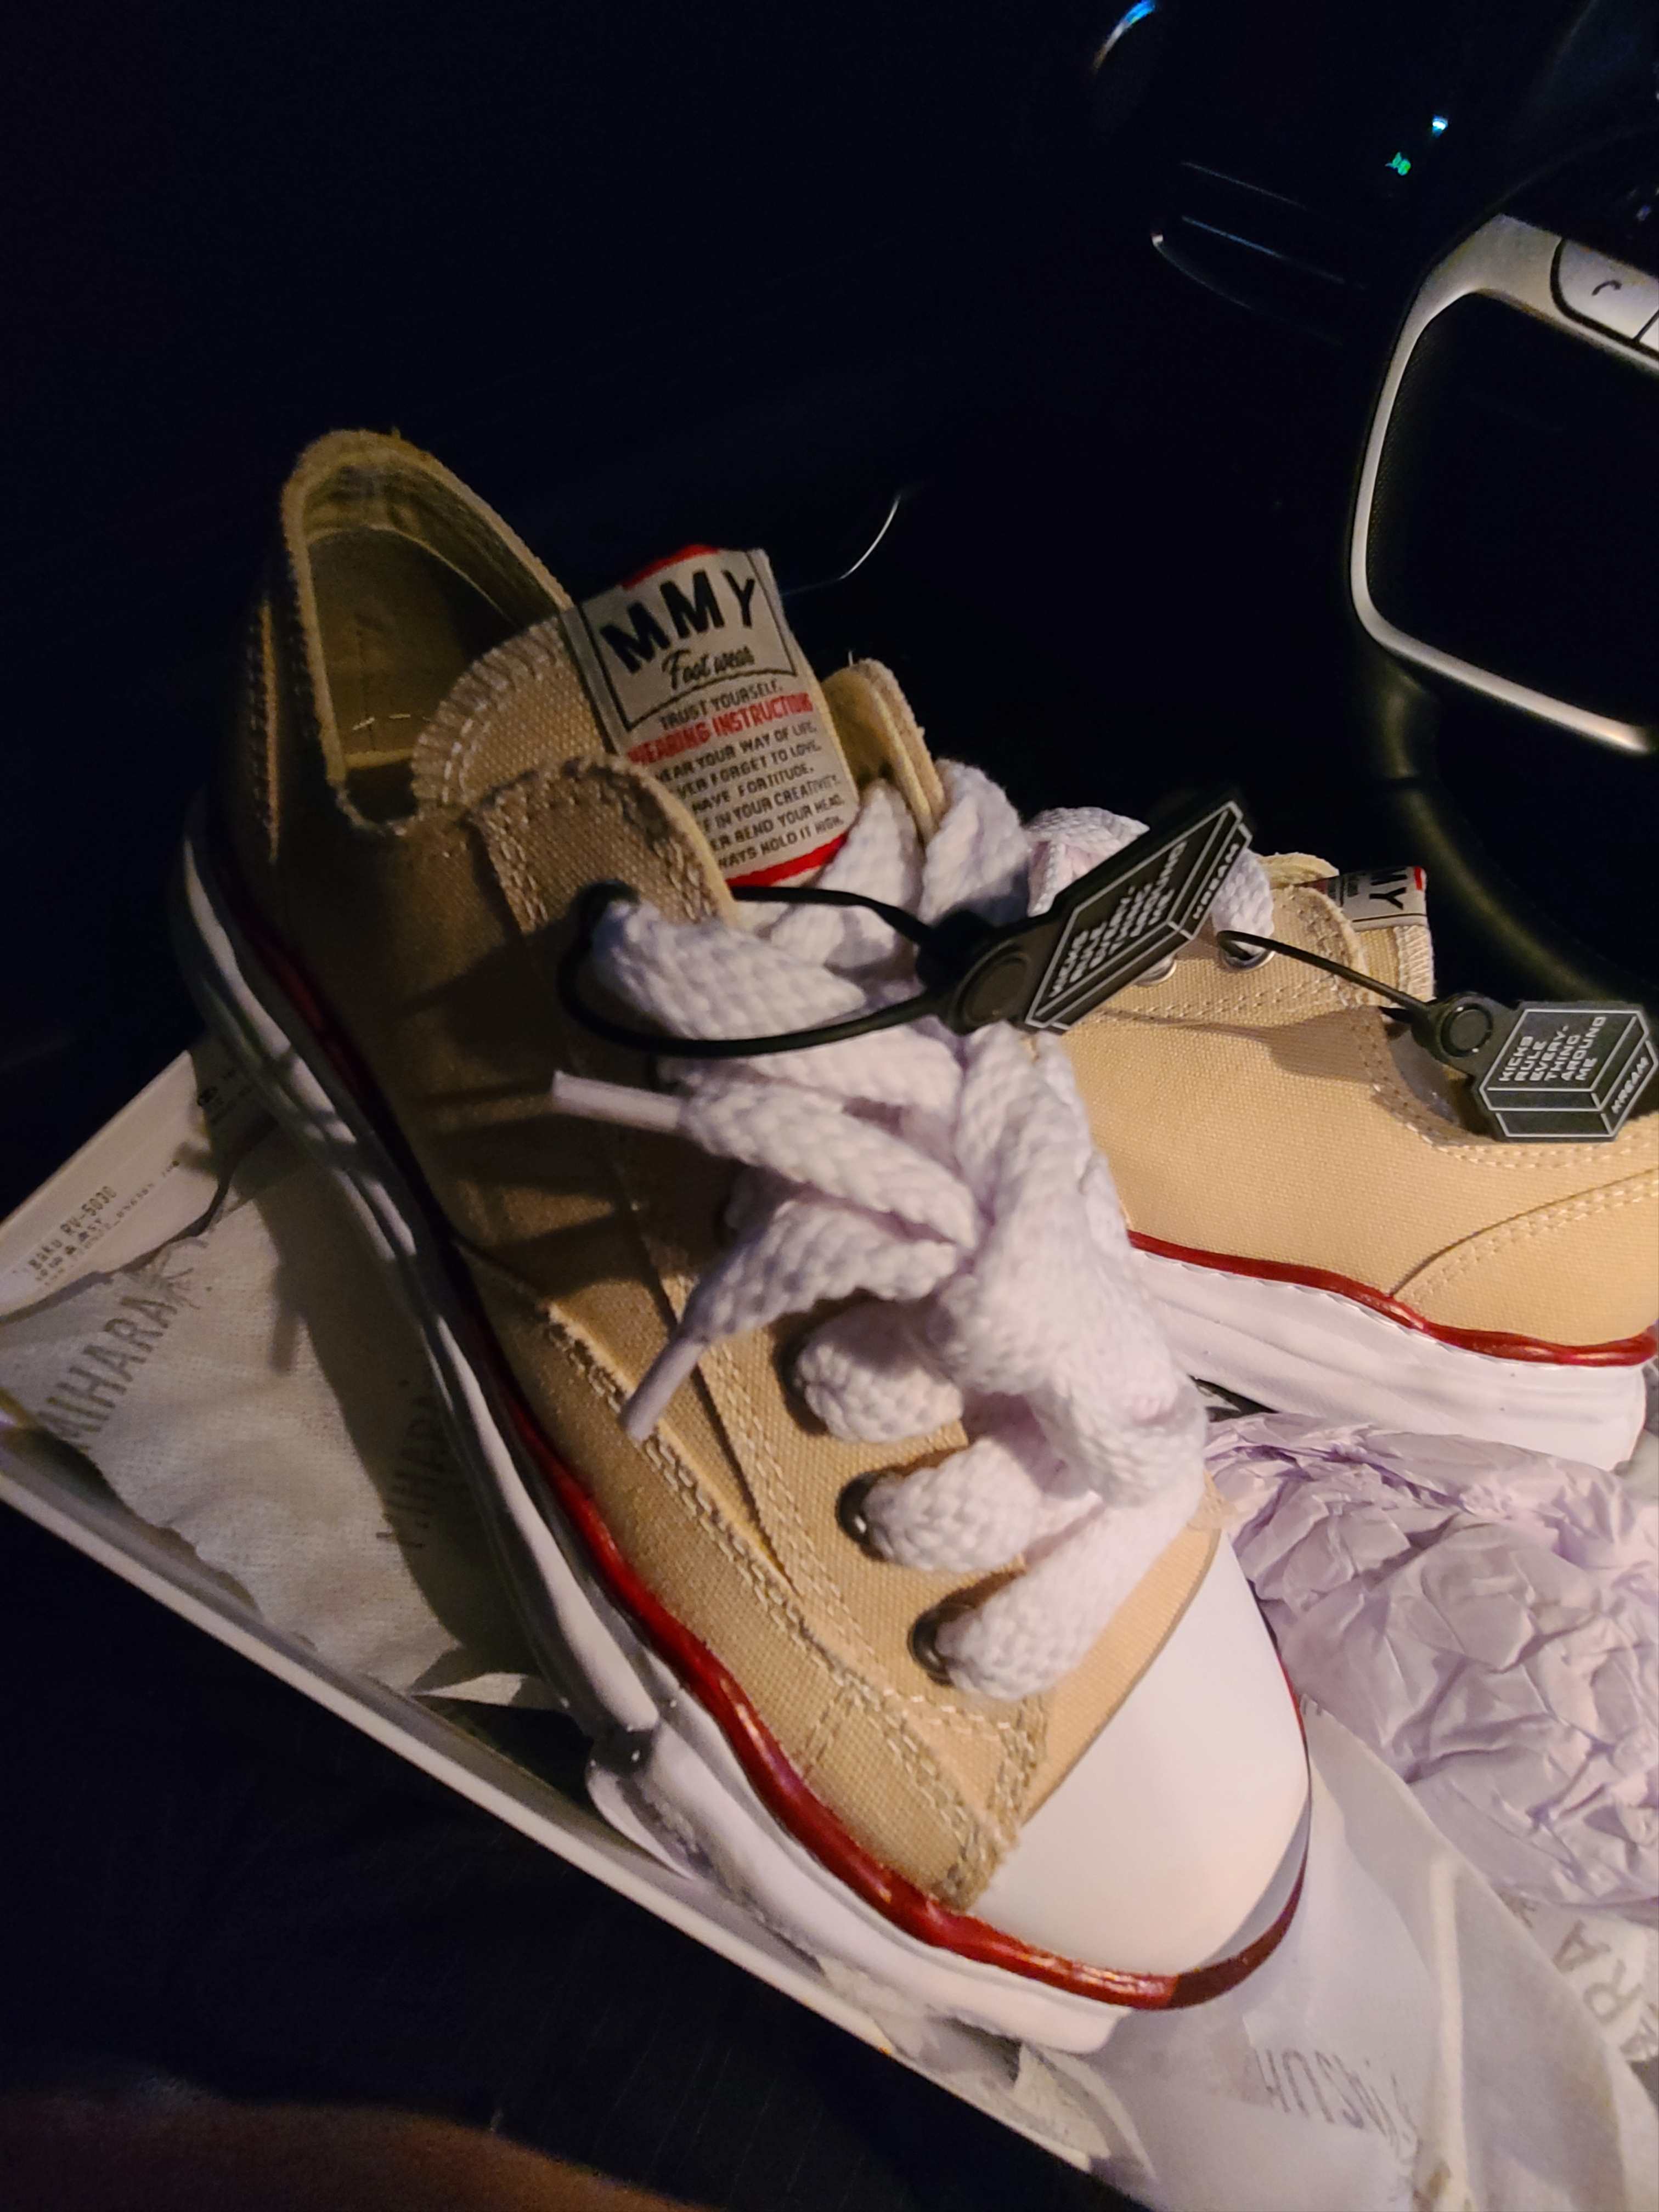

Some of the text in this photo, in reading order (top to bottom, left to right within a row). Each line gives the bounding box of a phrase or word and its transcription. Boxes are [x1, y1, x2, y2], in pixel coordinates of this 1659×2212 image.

[600, 569, 755, 674] MMY
[660, 699, 707, 730] TRUST
[655, 761, 695, 783] EAR
[696, 744, 736, 770] YOUR
[739, 733, 770, 754] WAY
[774, 727, 788, 742] OF
[710, 754, 767, 786] FORGET
[770, 748, 788, 765] TO
[732, 797, 773, 822] YOUR
[777, 804, 813, 827] YOUR
[760, 831, 798, 856] HOLD
[799, 825, 812, 840] IT
[1129, 840, 1188, 938] AROUND
[1148, 888, 1175, 926] ME
[1070, 921, 1108, 983] RULE
[1498, 1035, 1534, 1082] KICKS
[1514, 1041, 1547, 1081] RULE
[1543, 1034, 1581, 1081] THING
[1561, 1016, 1607, 1081] AROUND
[1575, 1057, 1598, 1081] ME
